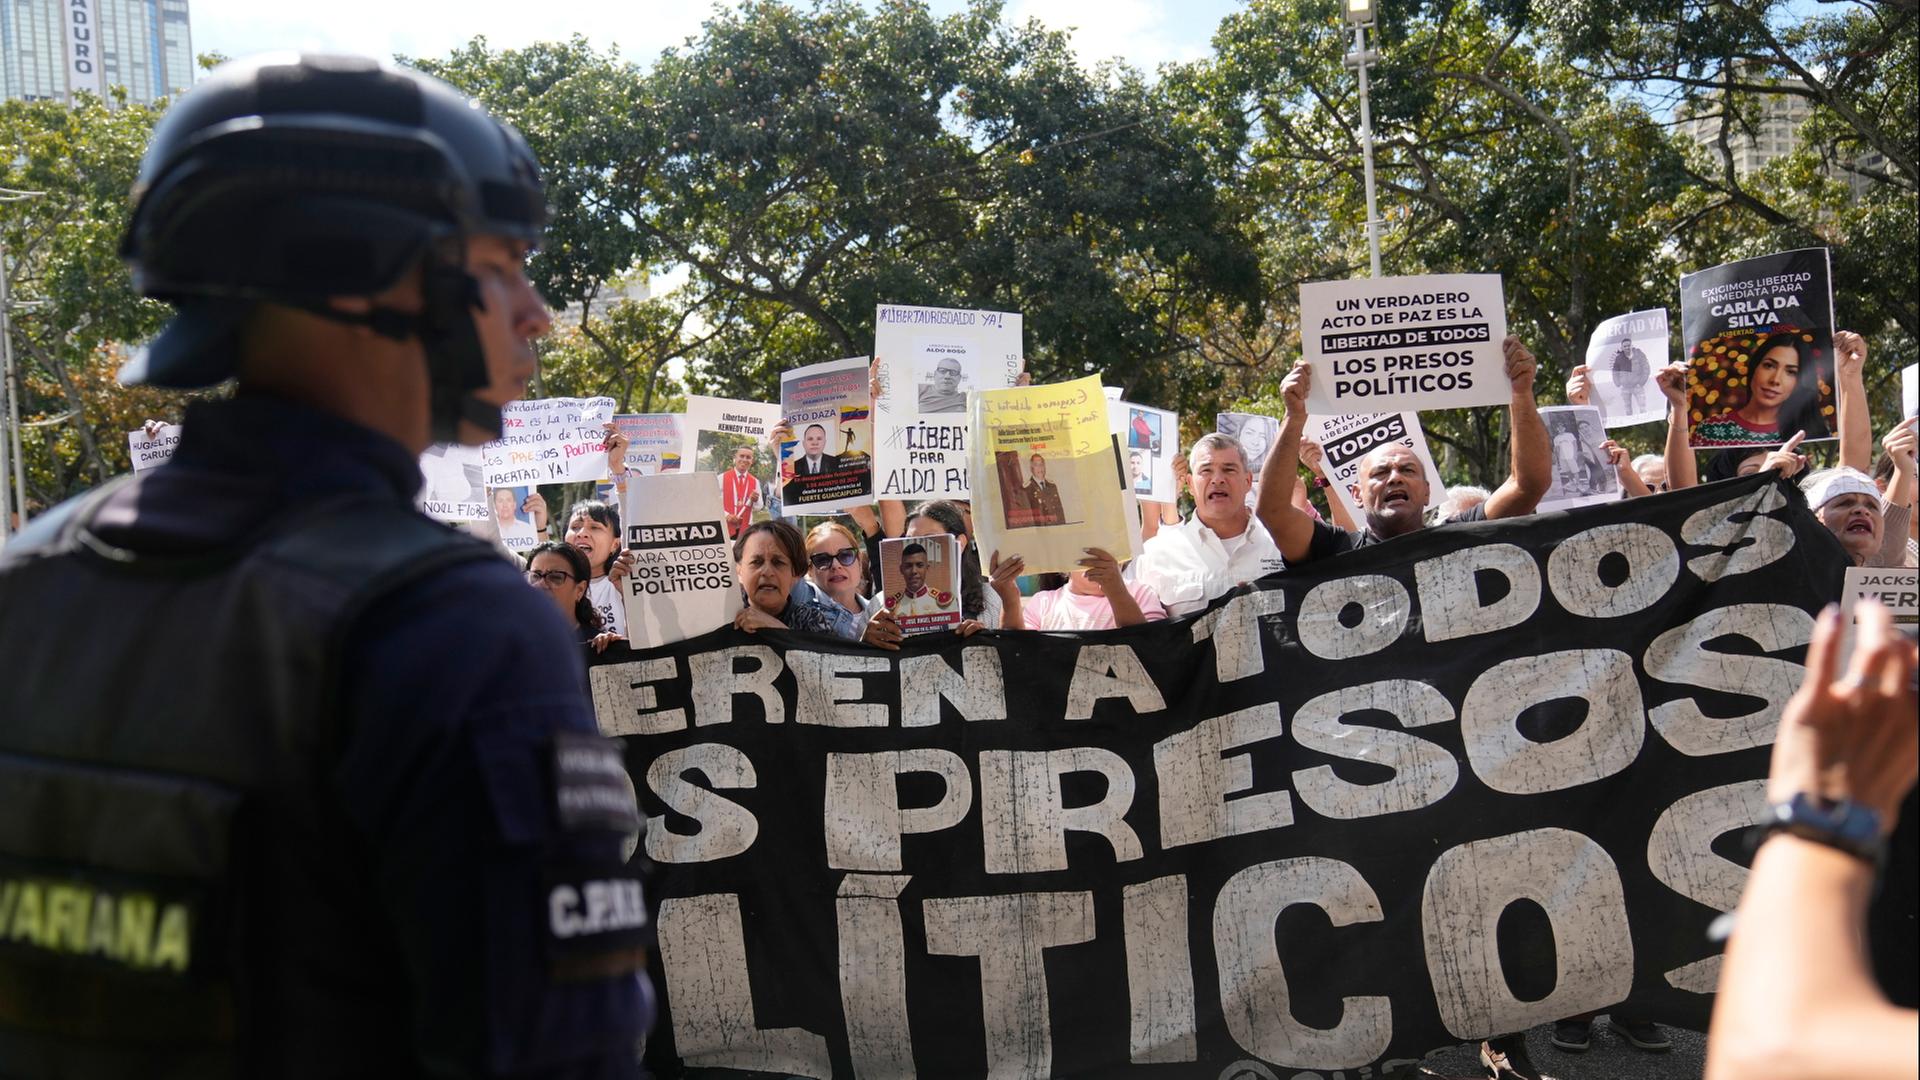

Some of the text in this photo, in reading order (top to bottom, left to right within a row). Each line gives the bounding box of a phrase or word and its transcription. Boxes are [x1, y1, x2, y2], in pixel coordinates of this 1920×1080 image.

[1701, 272, 1811, 298] EXIGIMOS LIBERTAD
[1707, 283, 1803, 304] INMEDIATA PARA
[1336, 292, 1470, 311] UN VERDADERO
[1711, 295, 1800, 317] CARLA DA
[1321, 307, 1483, 330] ACTO DE PAZ ES LA
[1607, 317, 1665, 338] ERTAD YA
[1727, 312, 1780, 328] SILVA
[1323, 327, 1489, 351] LIBERTAD DE TODOS
[1333, 350, 1475, 376] LOS PRESOS
[1335, 371, 1473, 399] POLÍTICOS
[503, 417, 525, 428] PAZ
[546, 415, 560, 425] La
[722, 413, 763, 425] Libertad para
[811, 409, 837, 421] DAZA
[558, 428, 572, 441] de
[718, 423, 765, 435] KENNEDY TEJEDA
[1320, 416, 1369, 441] LIBERTAD
[1327, 420, 1403, 461] TODOS
[141, 449, 172, 461] CARUC
[629, 454, 657, 464] DAZA
[909, 451, 945, 464] PARA
[486, 461, 570, 484] IBERTAD YA!
[881, 468, 935, 495] ALDO
[628, 525, 717, 543] LIBERTAD
[669, 547, 727, 562] TODOS
[630, 561, 730, 580] LOS PRESOS
[1859, 576, 1916, 586] JACKS
[632, 575, 733, 596] POLÍTICOS
[1064, 644, 1167, 720] A
[1192, 481, 1796, 683] TODOS
[824, 603, 1817, 875] PRESOS
